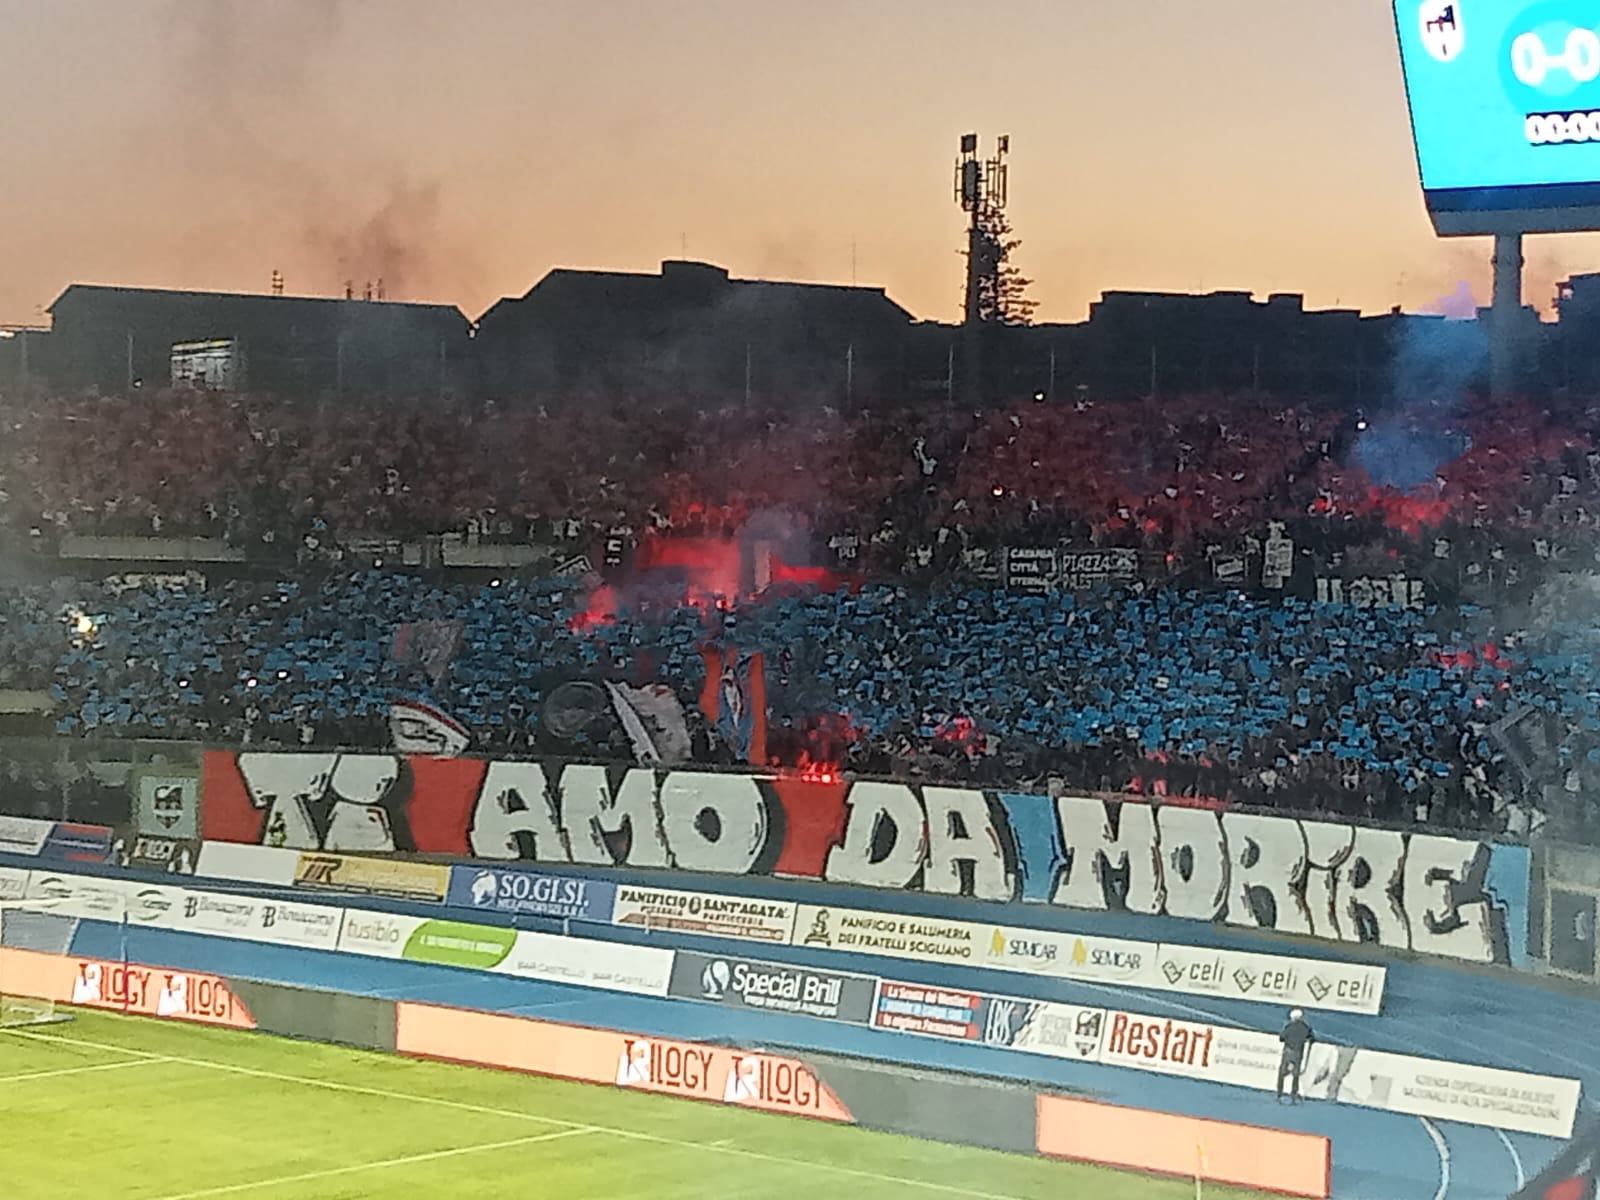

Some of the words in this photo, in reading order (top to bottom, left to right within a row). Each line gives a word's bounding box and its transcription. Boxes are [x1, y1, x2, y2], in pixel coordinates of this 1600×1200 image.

[470, 760, 767, 875] AMO
[826, 781, 1014, 901] DA
[620, 890, 687, 909] PANIFICIO
[837, 933, 856, 945] DEI
[840, 915, 896, 933] PANIFICIO
[898, 922, 906, 935] E
[908, 922, 972, 941] SALUMERIA
[732, 964, 802, 999] Special
[803, 976, 842, 1006] Brill
[1189, 956, 1225, 983] celi
[1261, 964, 1298, 990] celi
[1336, 971, 1374, 1000] celi
[1108, 1012, 1214, 1067] Restart
